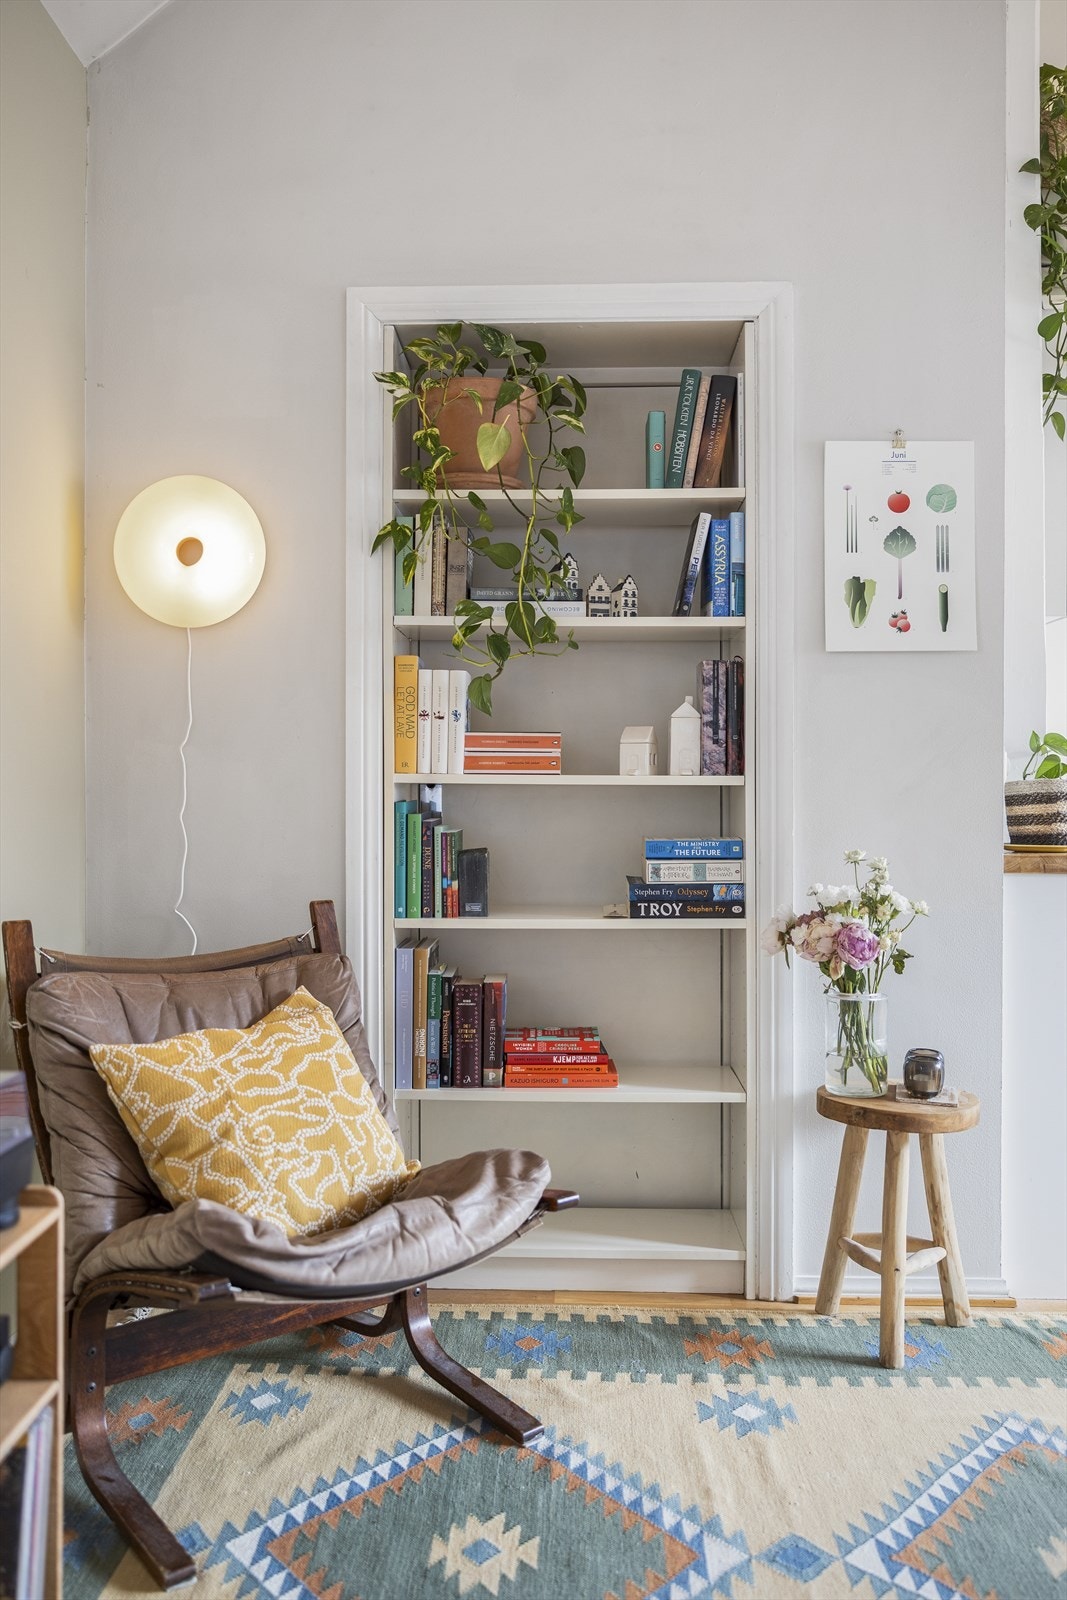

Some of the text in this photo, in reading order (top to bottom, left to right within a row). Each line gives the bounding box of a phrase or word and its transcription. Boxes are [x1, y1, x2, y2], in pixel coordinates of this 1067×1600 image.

[679, 392, 693, 426] TOLKIEN
[718, 398, 727, 423] WALTER
[706, 393, 722, 461] LEONARDO DA VINCI
[672, 429, 688, 473] HOBBITEN
[890, 451, 907, 459] Juni
[689, 556, 700, 575] PER
[714, 534, 727, 585] ASSYRIA
[396, 686, 405, 739] LET AT LAVE
[405, 686, 416, 739] GOD MAD
[424, 847, 432, 870] DUNE
[634, 887, 709, 897] Stephen Fry Odyssey
[637, 902, 726, 917] TROY Stephen Fry
[442, 1010, 451, 1053] Persuasion
[553, 1055, 576, 1063] KJEMP
